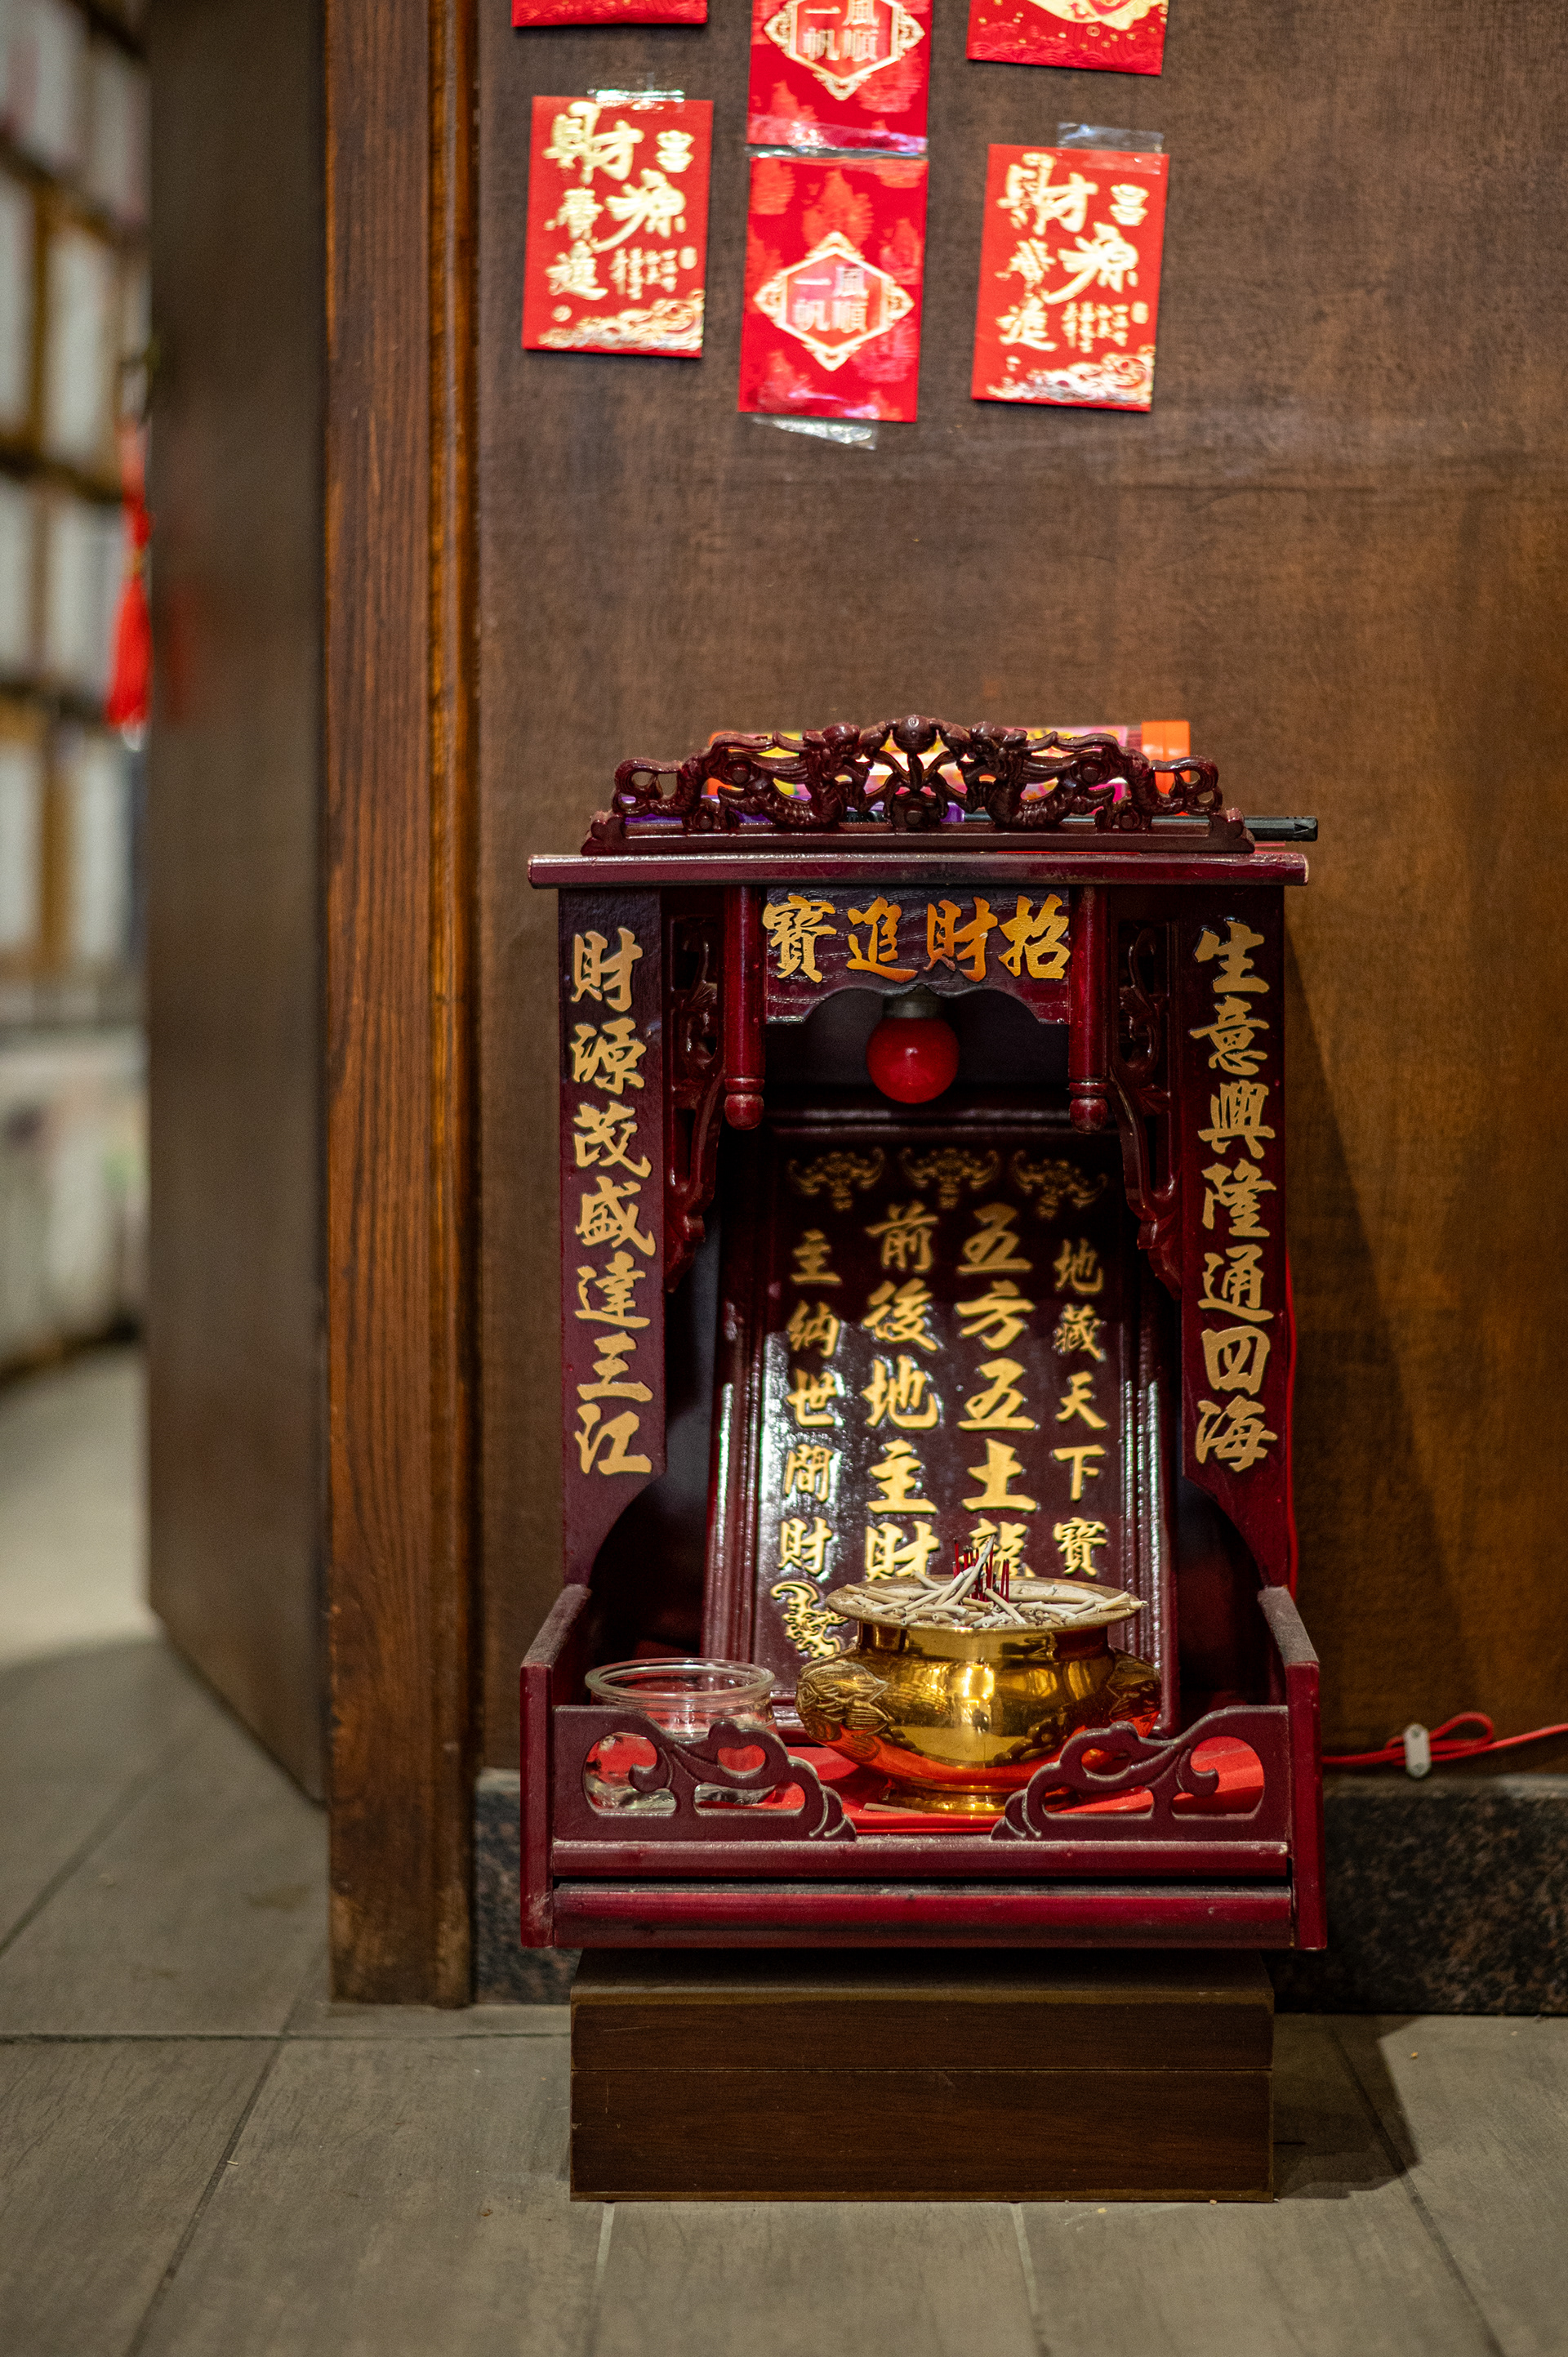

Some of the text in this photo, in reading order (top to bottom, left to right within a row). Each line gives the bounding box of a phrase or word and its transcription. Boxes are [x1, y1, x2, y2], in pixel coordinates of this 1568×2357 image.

[571, 927, 657, 1476] 財源茂盛達三江
[778, 1229, 843, 1576] 主納世間財
[1052, 1238, 1108, 1577] 地藏天下寶
[1190, 920, 1279, 1473] 生意興隆通四海
